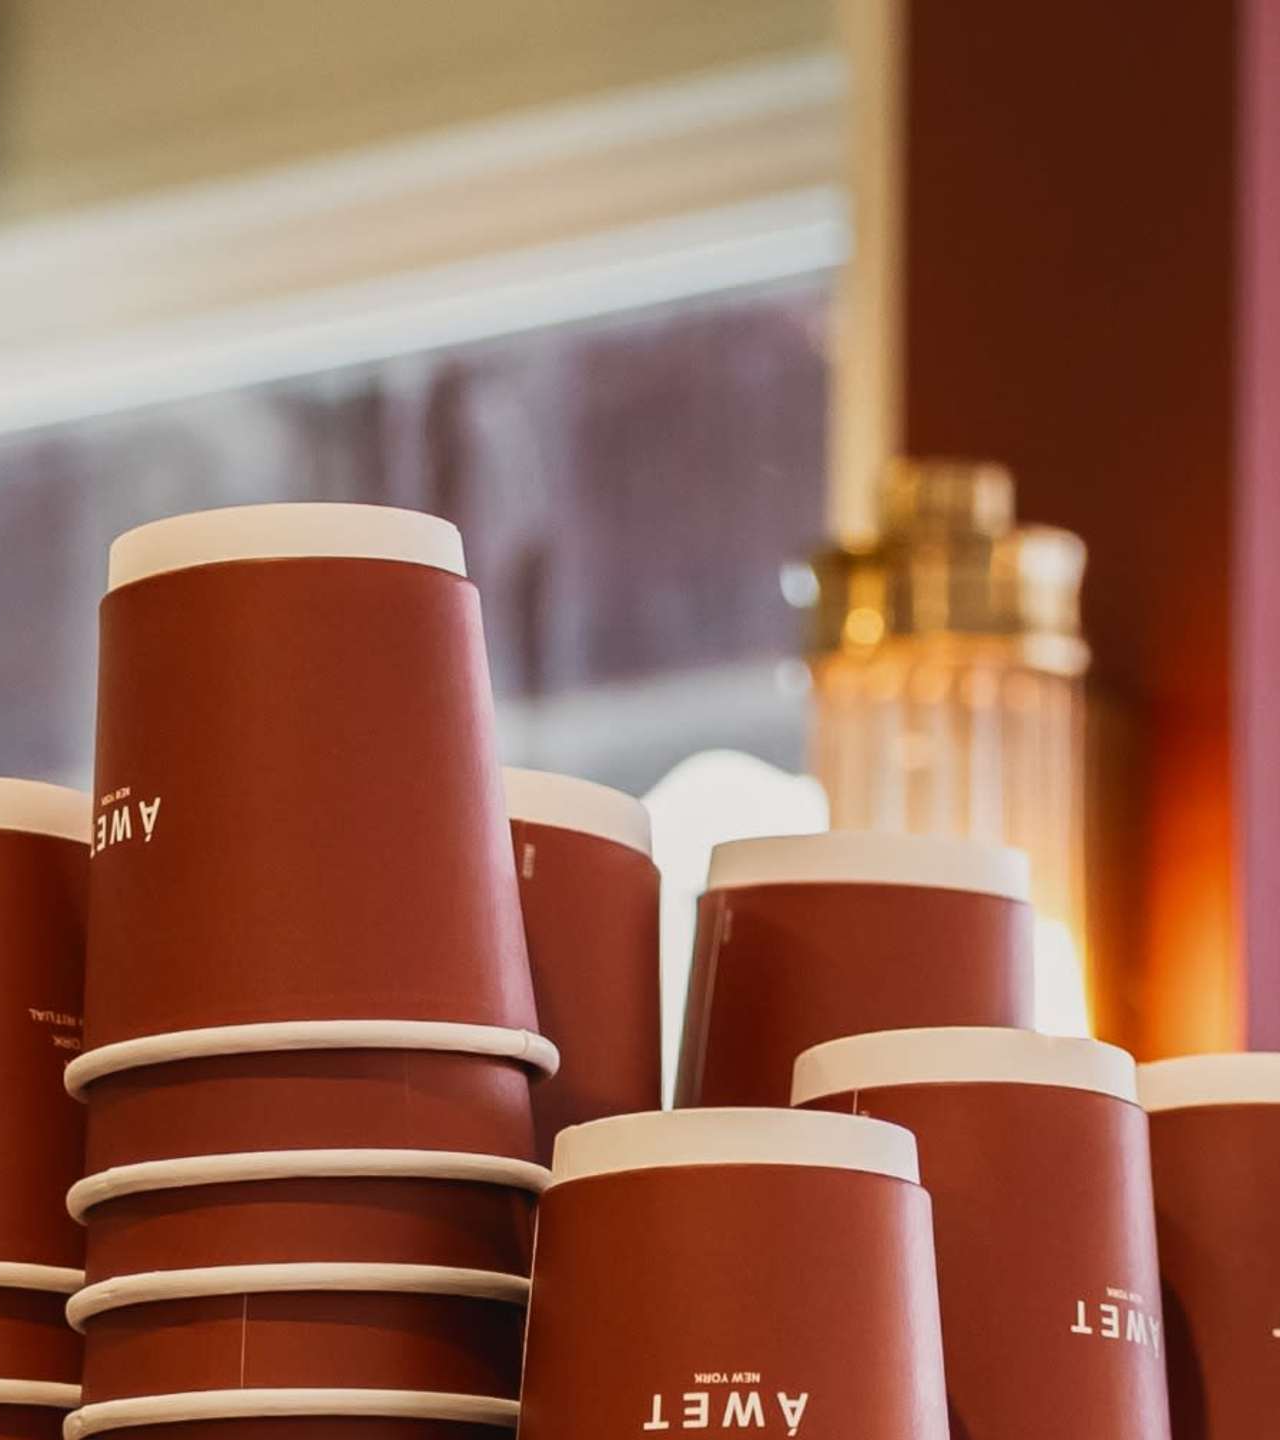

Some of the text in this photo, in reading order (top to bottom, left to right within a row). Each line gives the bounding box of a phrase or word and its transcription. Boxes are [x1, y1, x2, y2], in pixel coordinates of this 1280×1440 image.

[694, 1371, 761, 1384] NEW YORK
[642, 1390, 810, 1438] ÁWET
